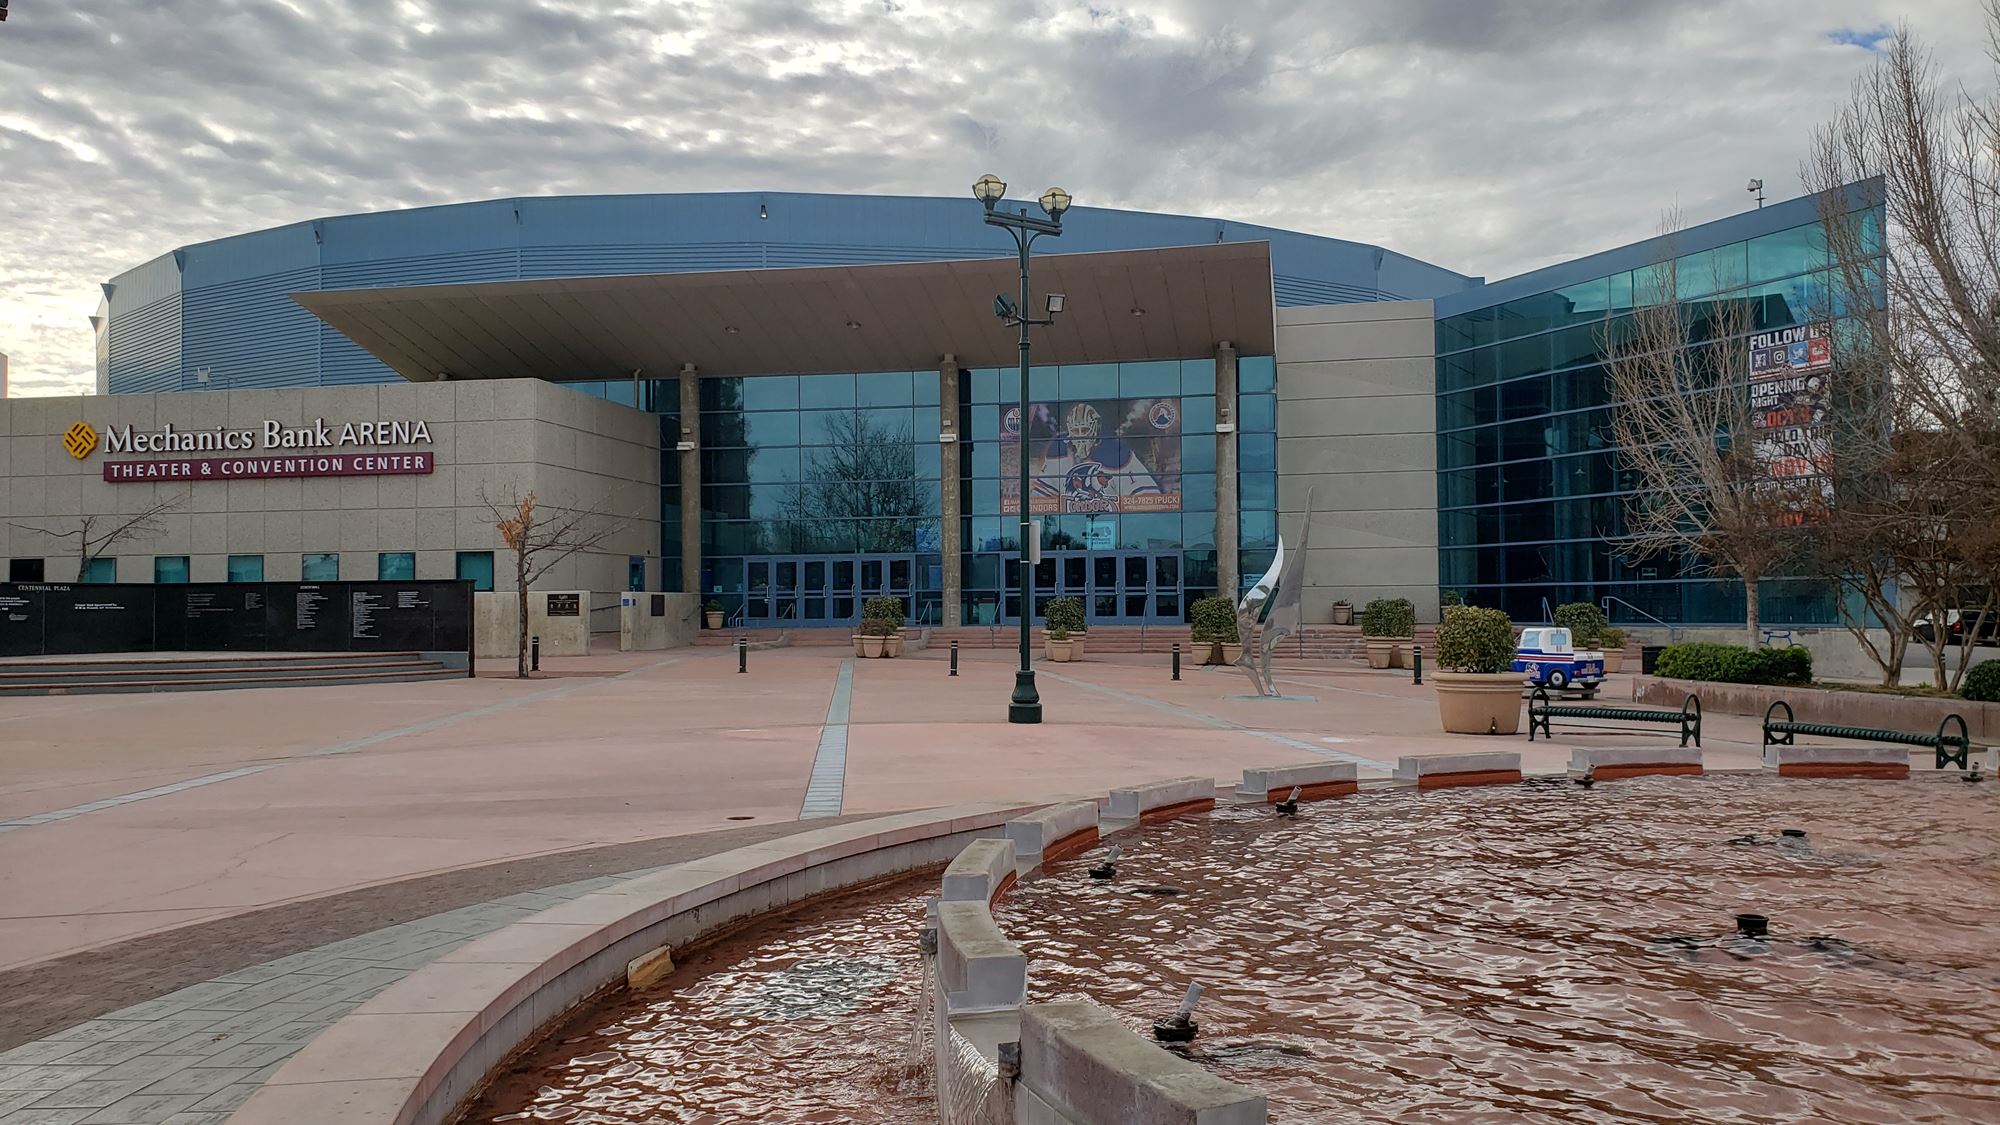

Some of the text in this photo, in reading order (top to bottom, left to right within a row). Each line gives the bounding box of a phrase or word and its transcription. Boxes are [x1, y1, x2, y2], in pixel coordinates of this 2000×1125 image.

[1750, 326, 1806, 350] FOLLOW
[1752, 378, 1805, 396] OPENING
[1752, 395, 1779, 408] NIGHT
[104, 418, 433, 453] Mechanics Bank ARENA
[111, 456, 425, 478] THEATER & CONVENTION CENTER
